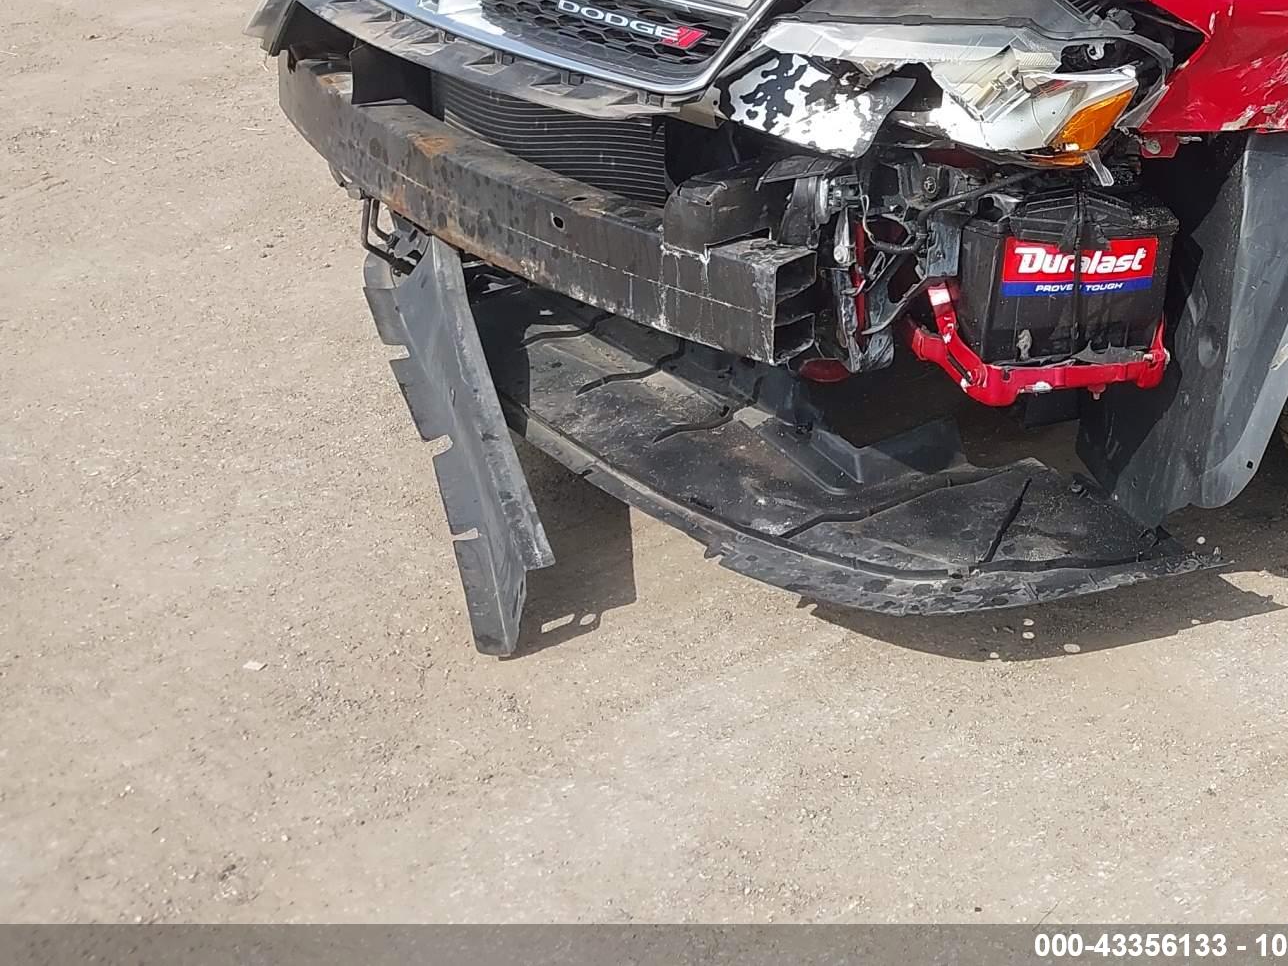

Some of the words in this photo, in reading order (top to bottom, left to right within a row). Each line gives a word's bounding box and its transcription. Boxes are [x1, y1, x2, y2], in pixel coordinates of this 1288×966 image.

[557, 0, 681, 42] DODGE
[1014, 247, 1147, 275] Duralast
[1035, 283, 1082, 293] PROVE
[1085, 282, 1124, 292] TOUGH
